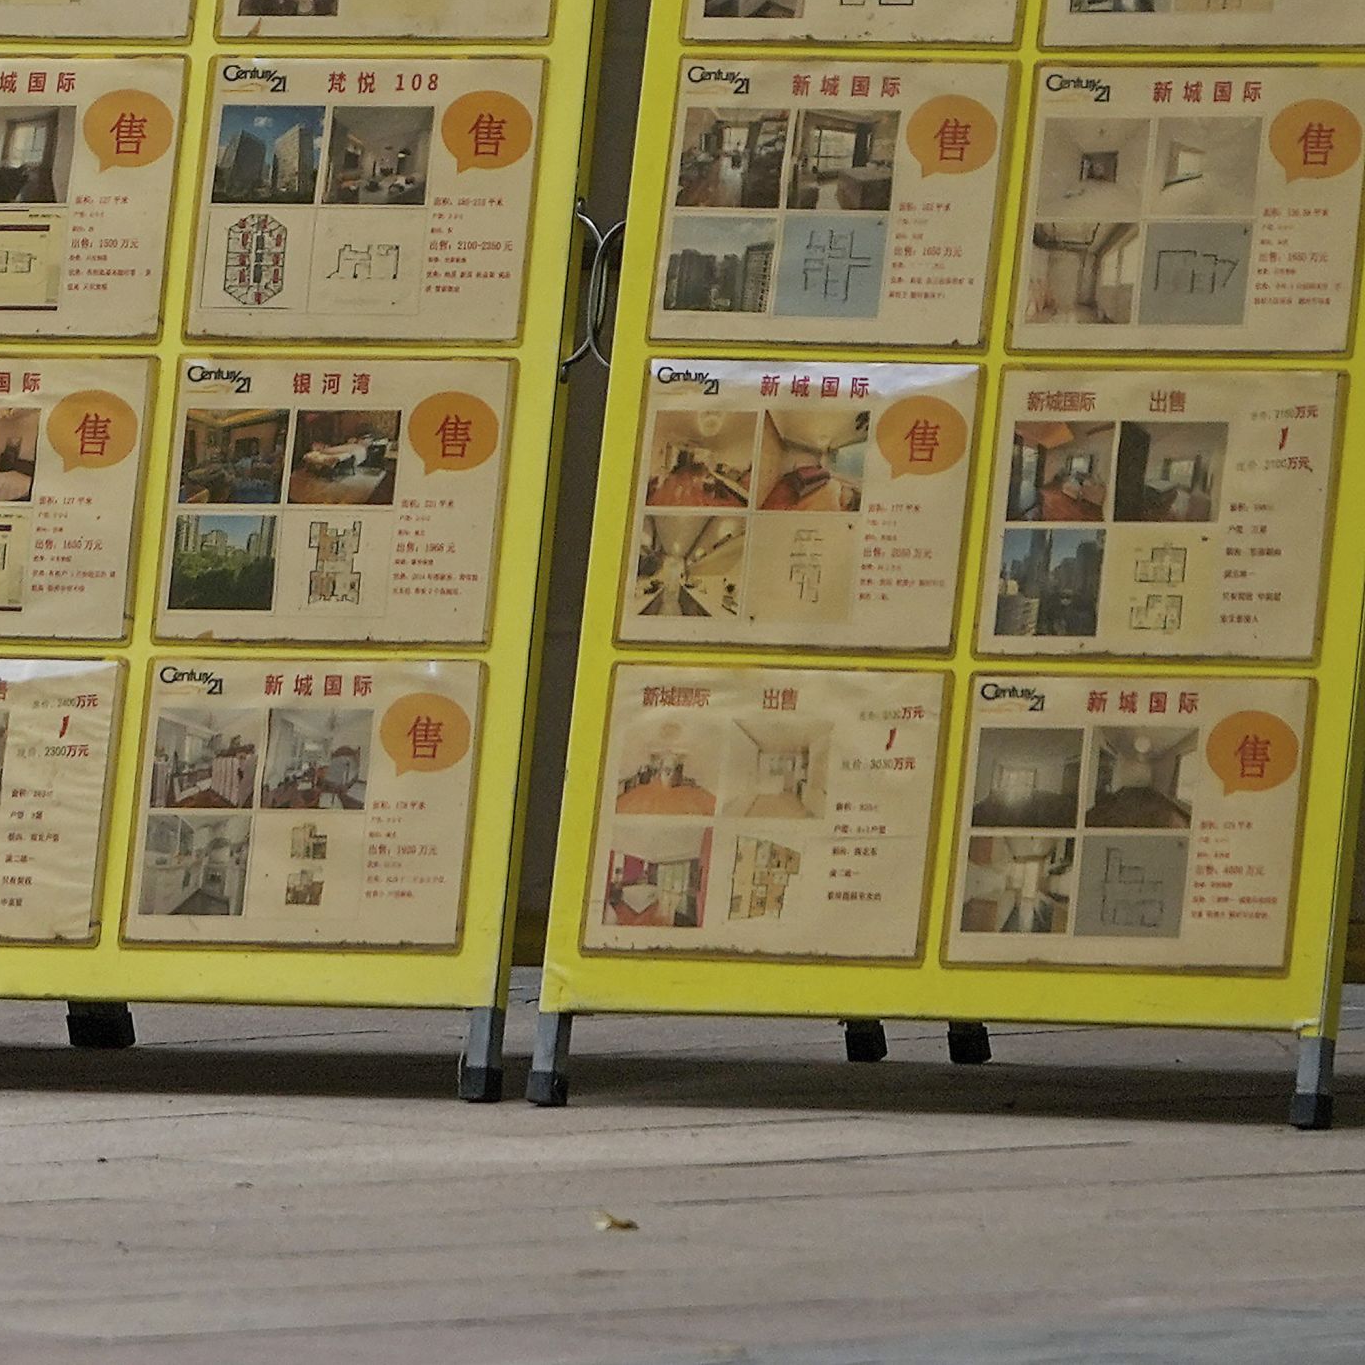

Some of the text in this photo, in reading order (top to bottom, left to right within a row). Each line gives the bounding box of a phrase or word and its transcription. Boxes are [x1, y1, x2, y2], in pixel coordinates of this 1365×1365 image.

[223, 65, 286, 93] Century 21
[328, 71, 439, 94] 梵悦 108
[688, 67, 749, 94] Century 21
[792, 74, 901, 97] 新城国际
[1153, 81, 1262, 103] 新城国际
[110, 112, 147, 155] 售
[468, 113, 508, 156] 售
[934, 118, 971, 162] 售
[293, 373, 371, 395] 银河湾
[760, 375, 870, 399] 新城国际
[1028, 390, 1186, 413] 新城国际 出售
[75, 412, 111, 456] 售
[435, 414, 471, 458] 售
[905, 419, 940, 462] 售
[265, 674, 373, 697] 新城国际
[1087, 690, 1200, 714] 新城国际
[407, 716, 444, 759] 售
